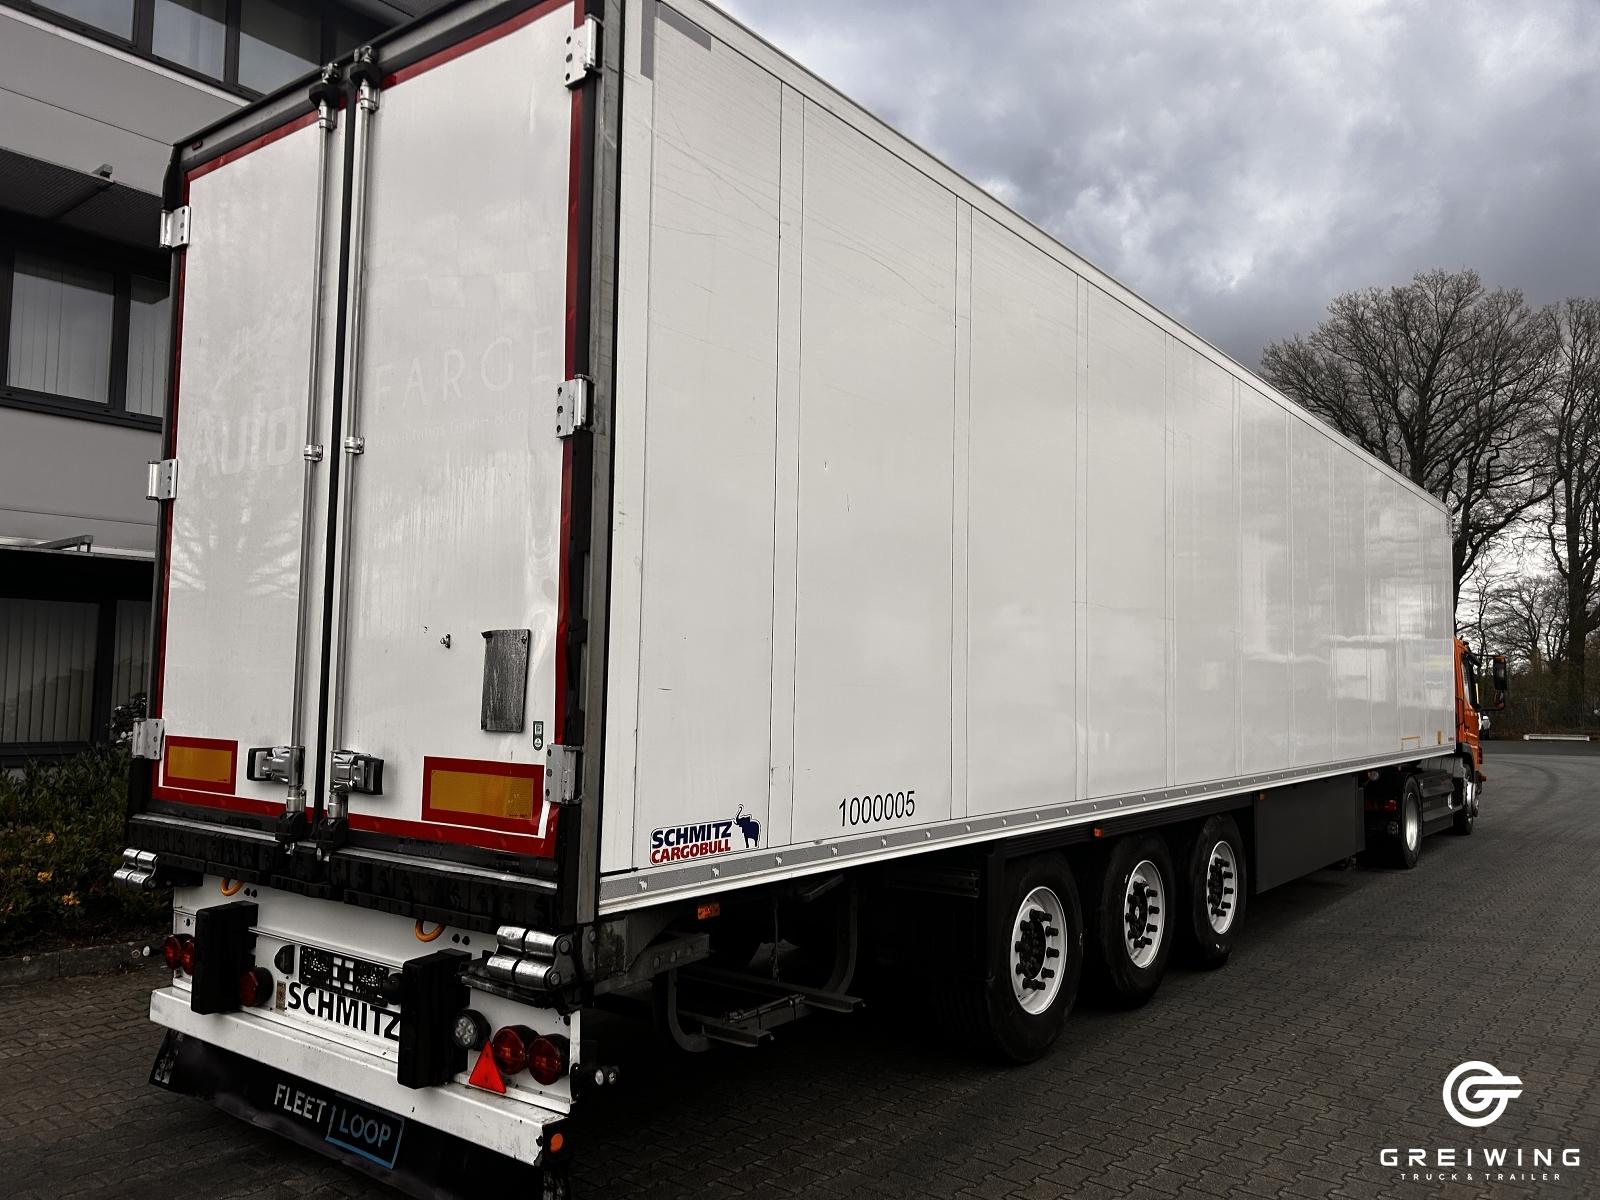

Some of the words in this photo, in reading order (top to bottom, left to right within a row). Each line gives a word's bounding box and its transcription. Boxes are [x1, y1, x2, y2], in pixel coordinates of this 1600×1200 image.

[838, 790, 916, 827] 1000005
[651, 820, 733, 848] SCHMITZ
[651, 838, 732, 864] CARGOBULL
[288, 981, 401, 1042] SCHMITZ
[273, 1083, 328, 1123] FLEET
[339, 1108, 392, 1148] LOOP
